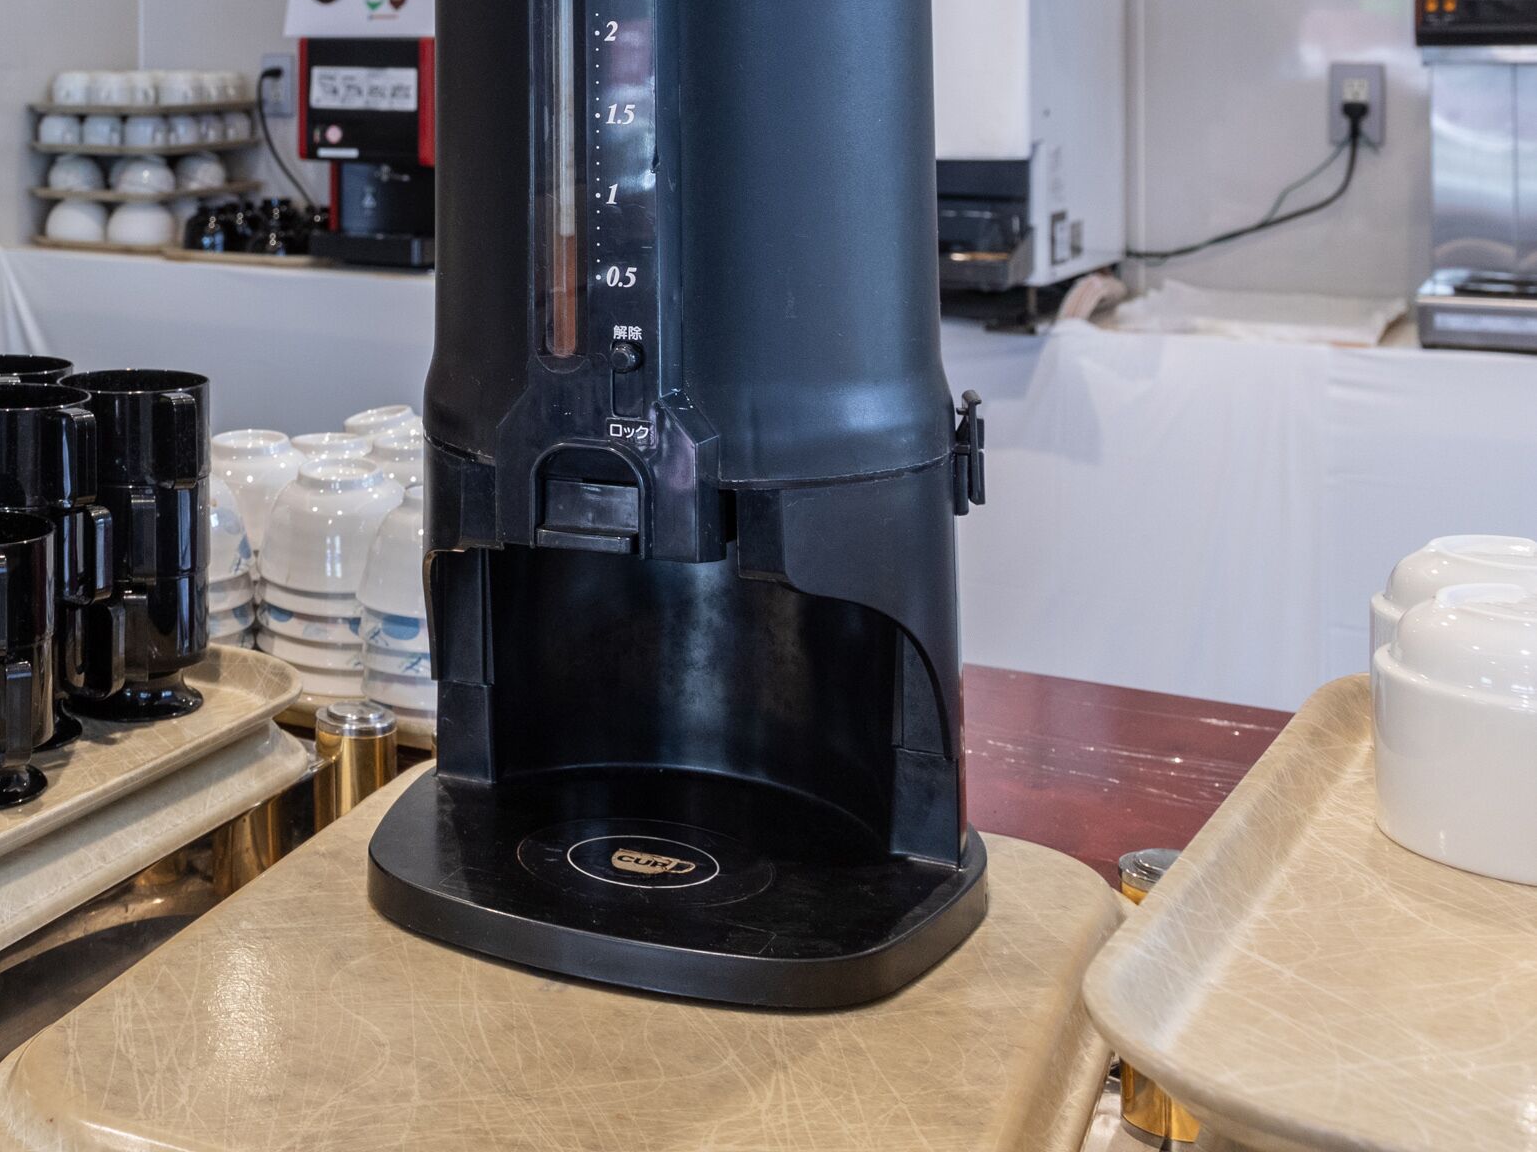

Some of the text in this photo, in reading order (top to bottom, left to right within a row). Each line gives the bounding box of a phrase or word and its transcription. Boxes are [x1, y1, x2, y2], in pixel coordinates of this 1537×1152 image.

[604, 21, 619, 42] 2
[605, 104, 636, 125] 1.5
[605, 183, 619, 205] 1
[606, 266, 638, 288] 0.5
[613, 325, 643, 340] 解除
[609, 423, 650, 440] ロック
